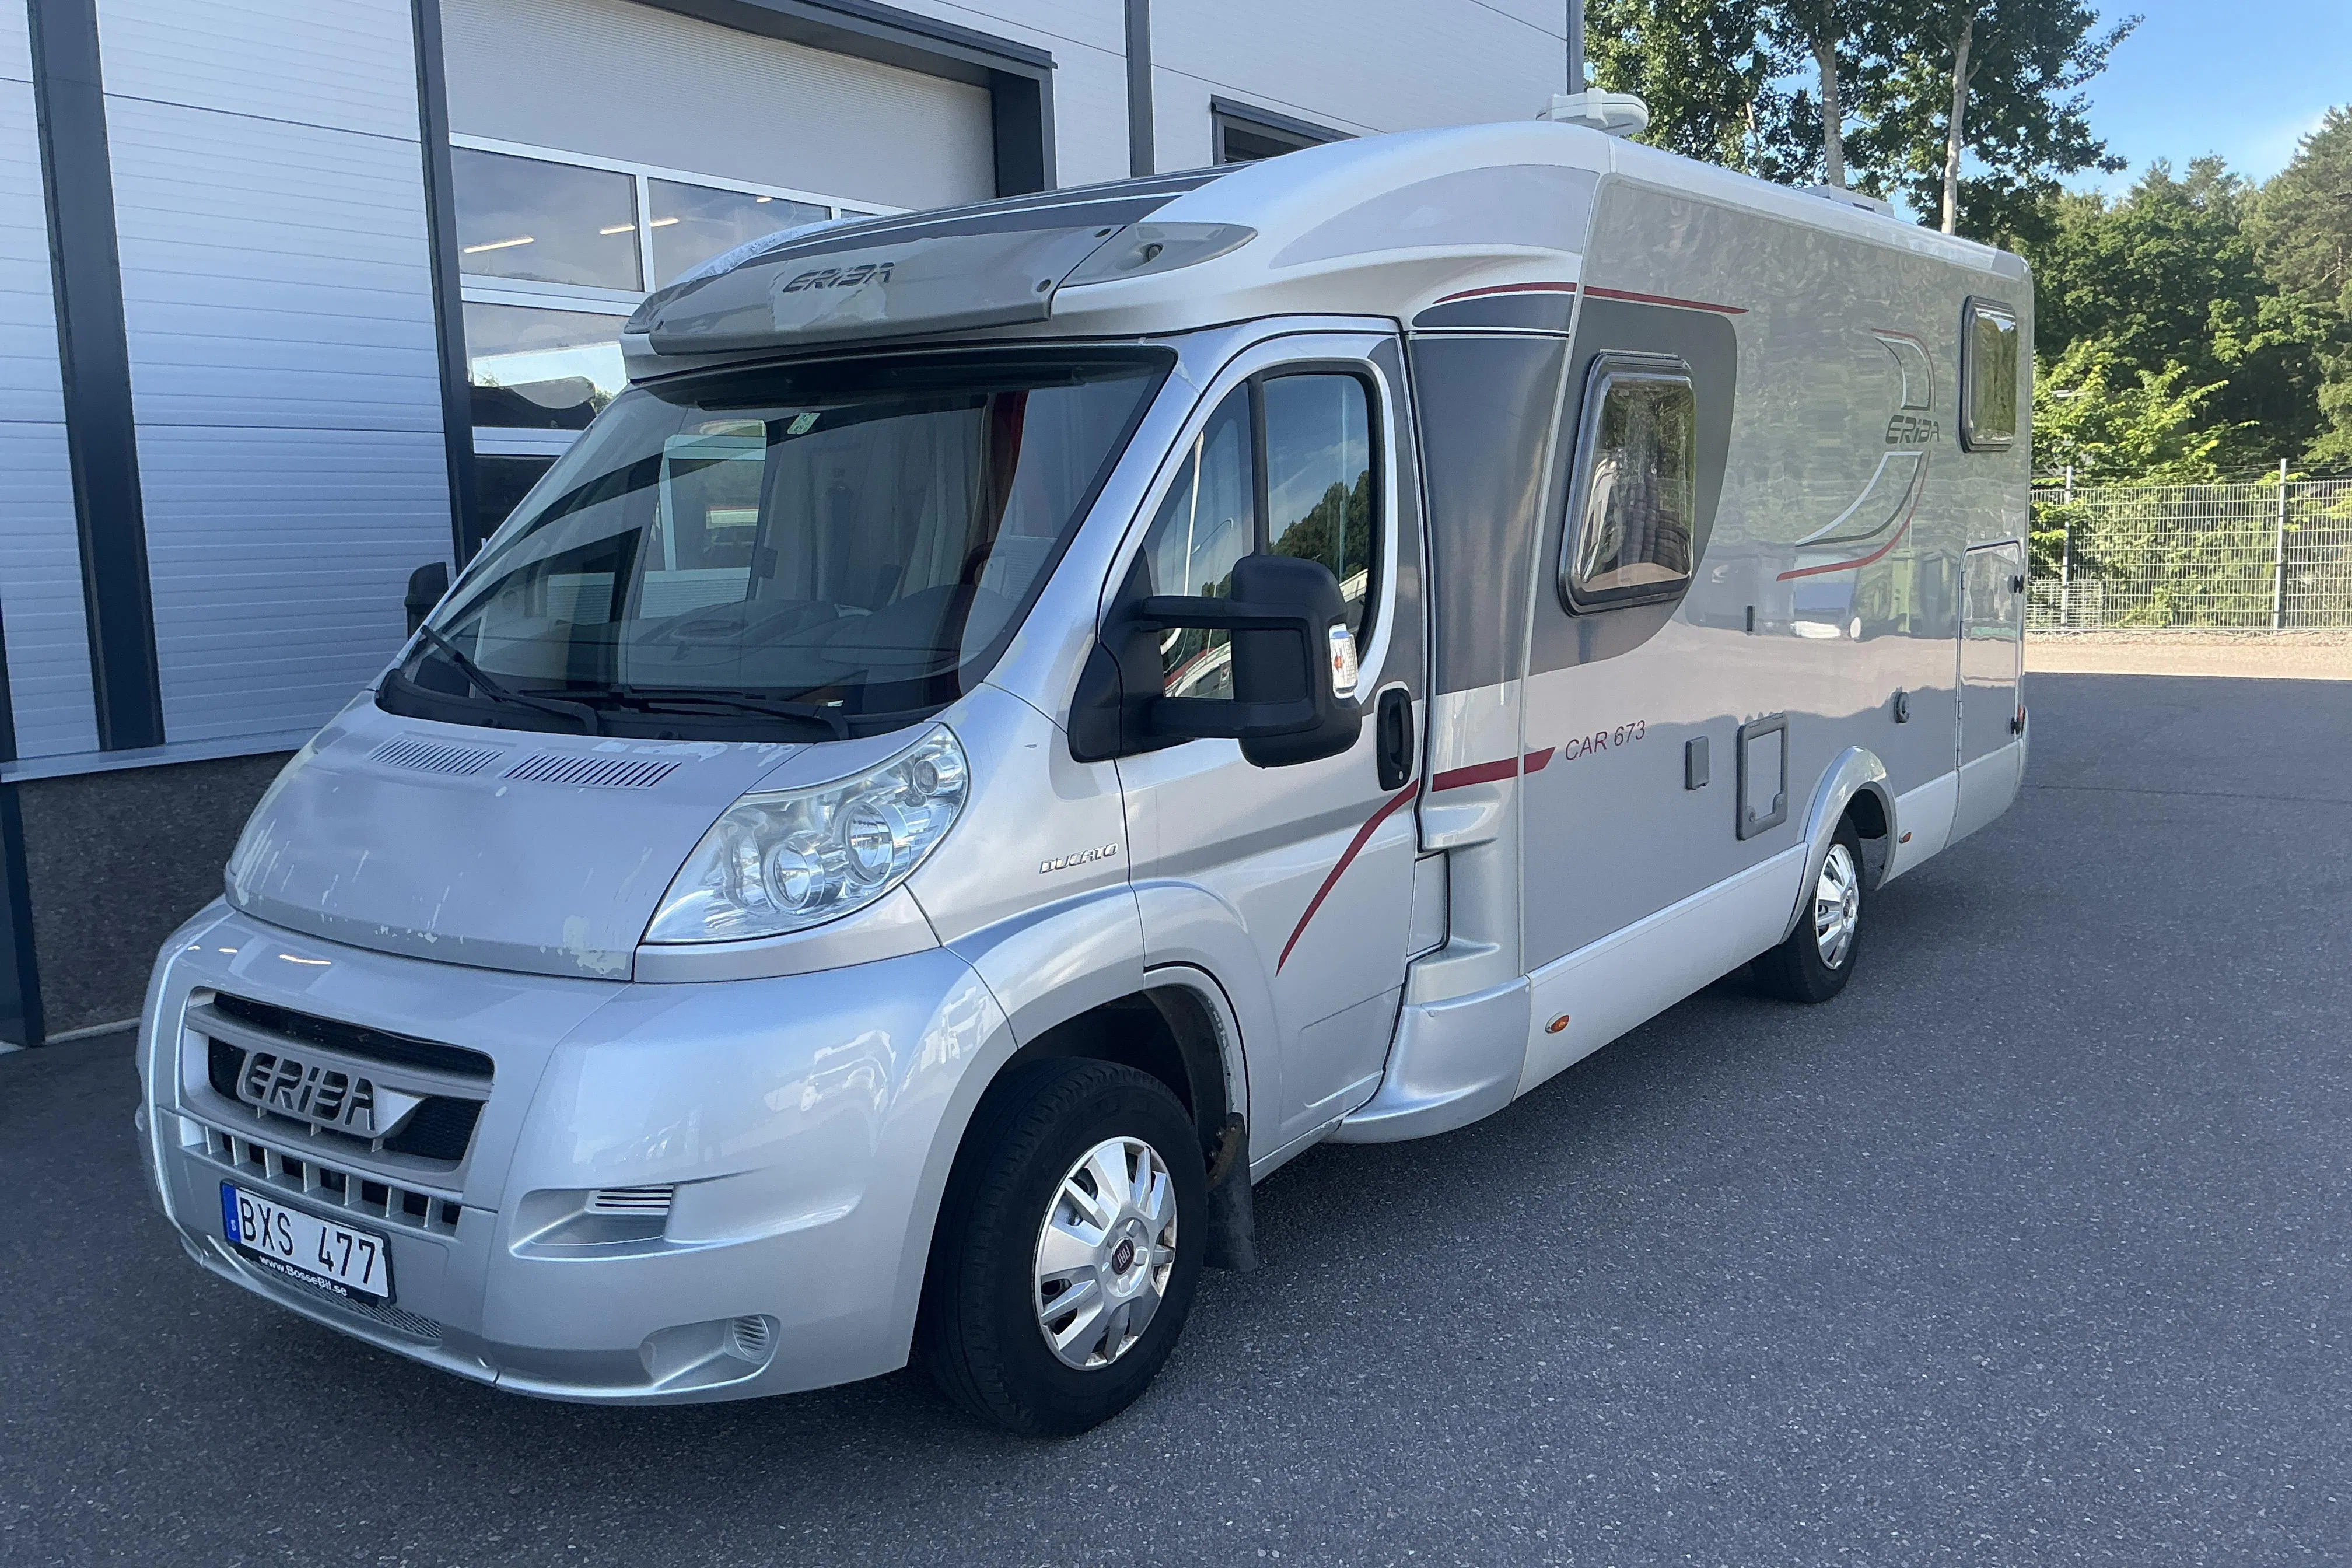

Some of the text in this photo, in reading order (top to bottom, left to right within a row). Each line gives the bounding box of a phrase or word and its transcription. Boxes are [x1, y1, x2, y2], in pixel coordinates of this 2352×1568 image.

[1566, 720, 1645, 760] CAR 673
[1040, 843, 1118, 874] DUCATO
[231, 1220, 236, 1231] S
[240, 1197, 375, 1284] BXS 477
[1117, 1244, 1130, 1268] FIAT
[259, 1255, 347, 1296] www.BosseBil.se
